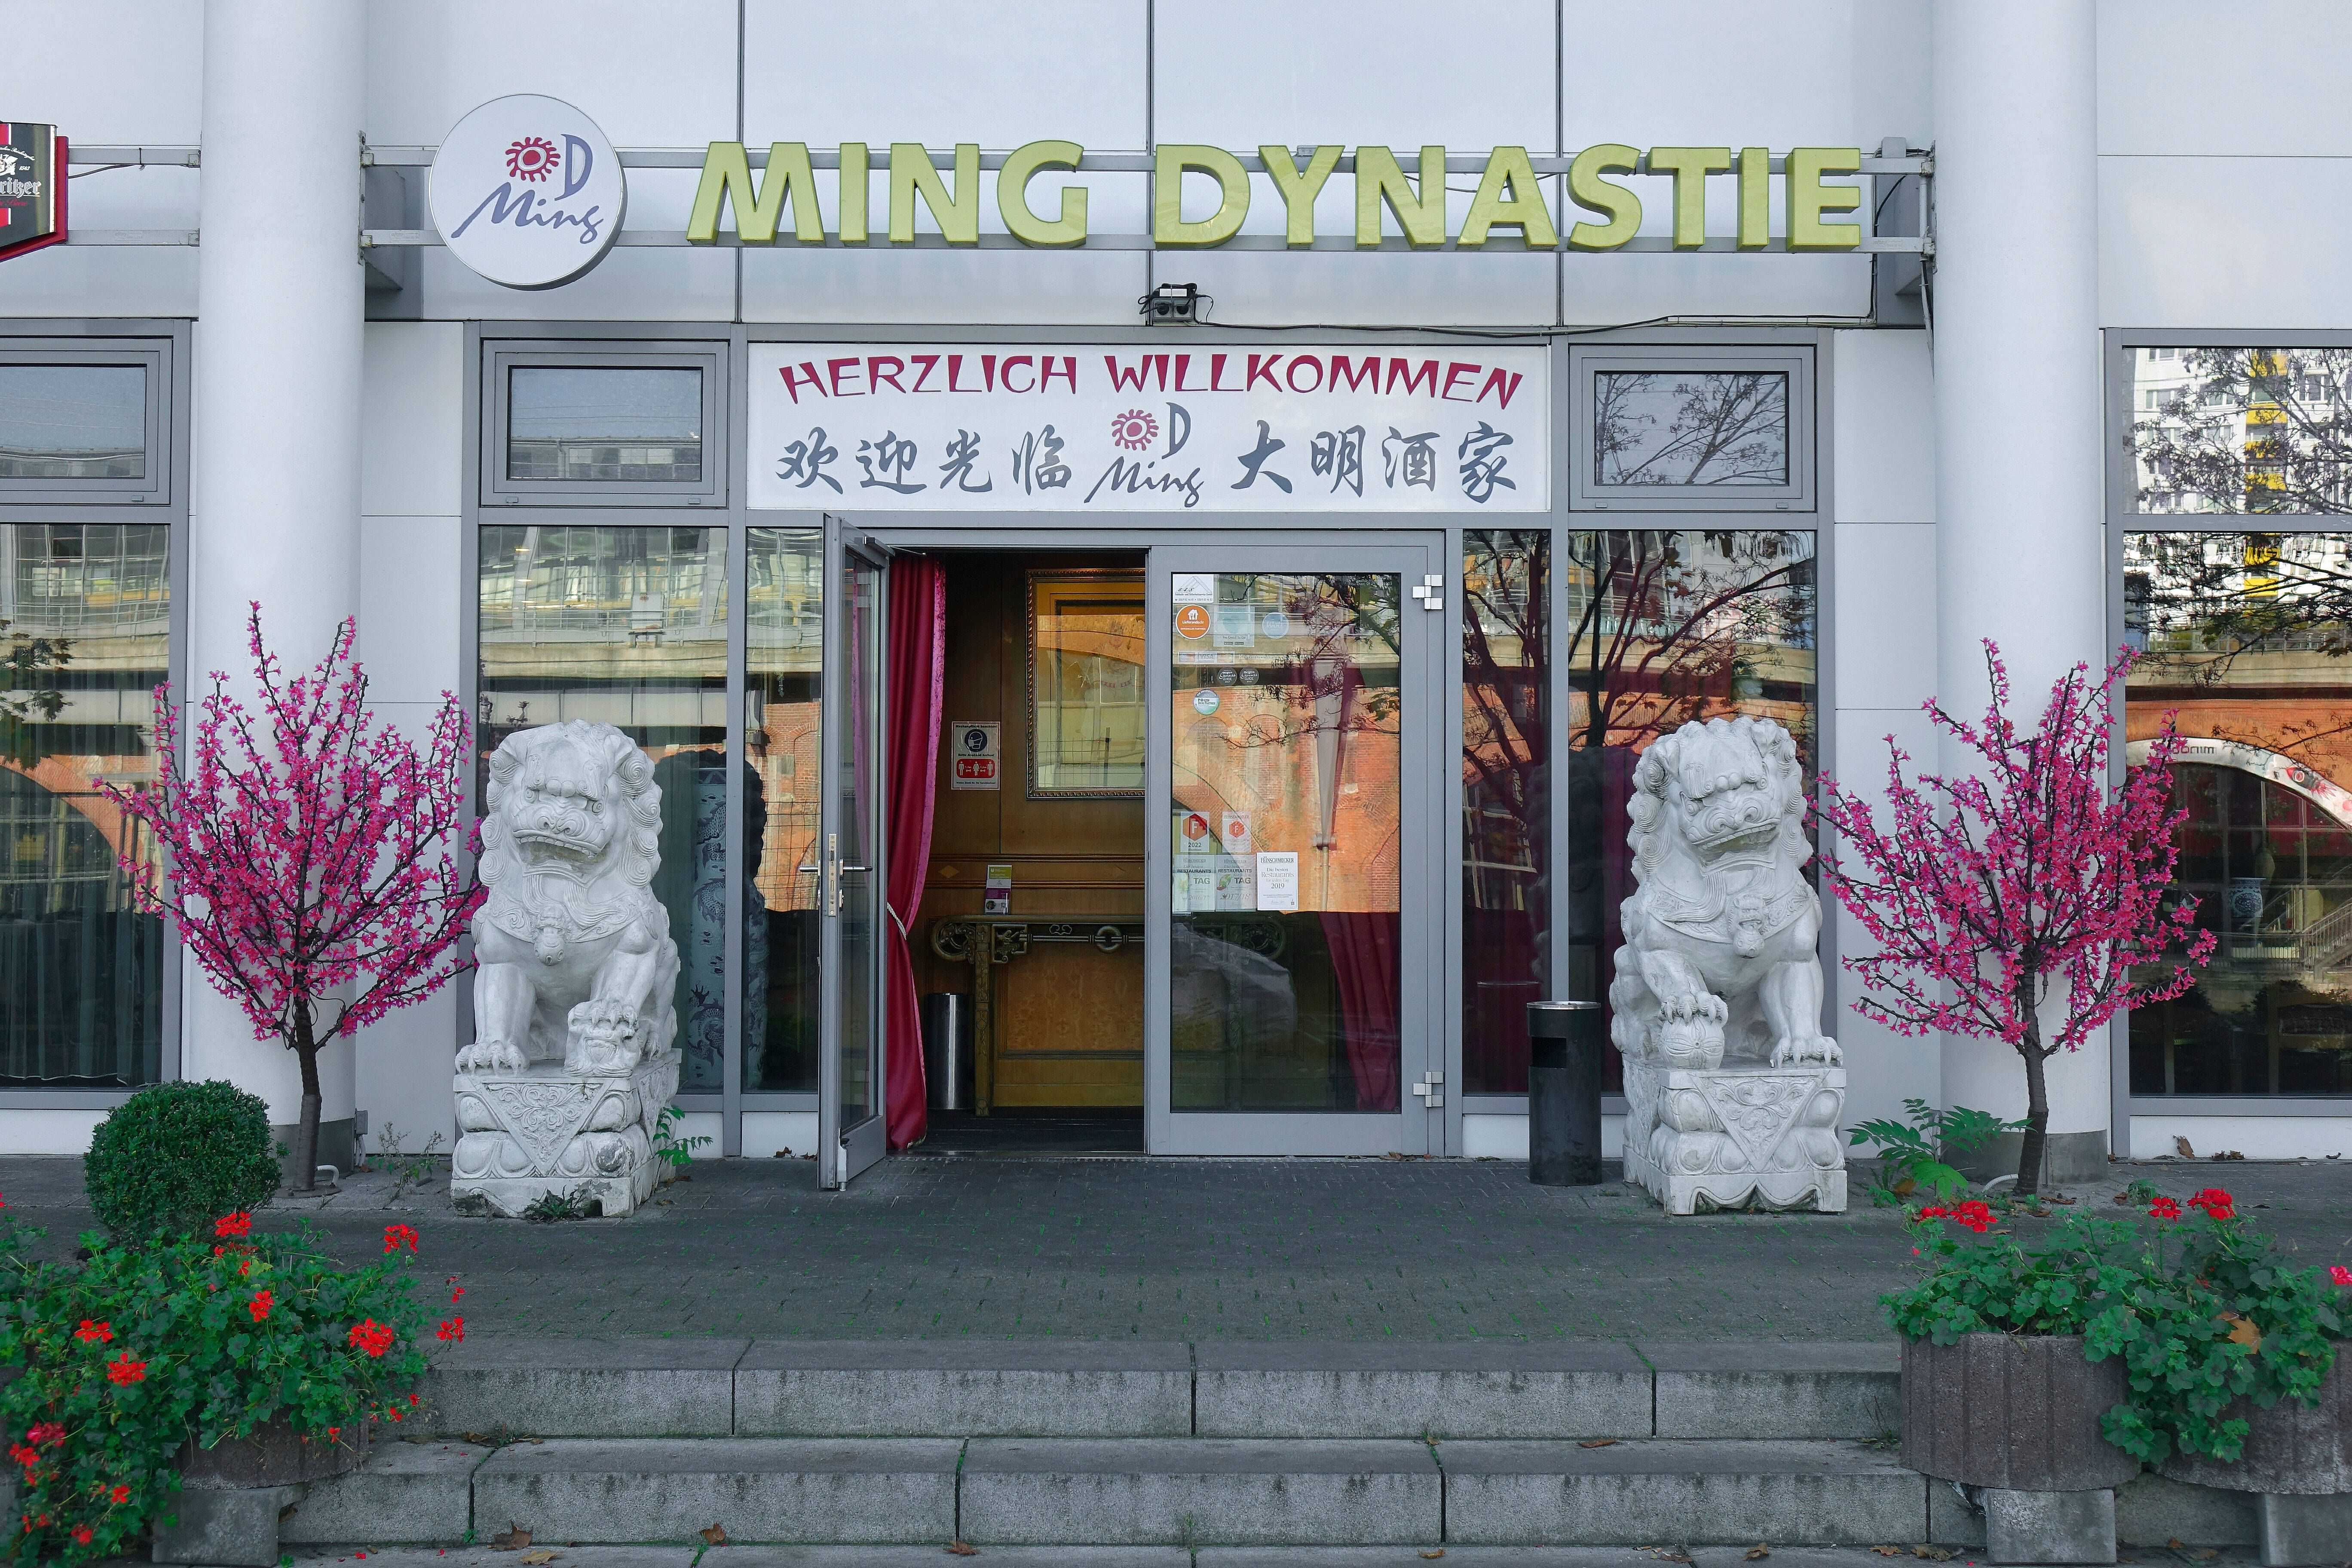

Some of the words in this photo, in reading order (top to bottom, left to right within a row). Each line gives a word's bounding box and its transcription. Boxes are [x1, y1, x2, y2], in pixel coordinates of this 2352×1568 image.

[554, 134, 593, 201] D
[686, 140, 1088, 246] MING
[1155, 143, 1861, 248] DYNASTIE
[451, 182, 603, 244] Ming
[779, 355, 1076, 404] HERZLICH
[1104, 354, 1523, 409] WILLKOMMEN
[775, 424, 1072, 495] 欢迎光临
[1162, 402, 1191, 459] D
[1231, 420, 1516, 503] 大明酒家
[1084, 456, 1206, 507] Ming
[1191, 821, 1198, 833] F
